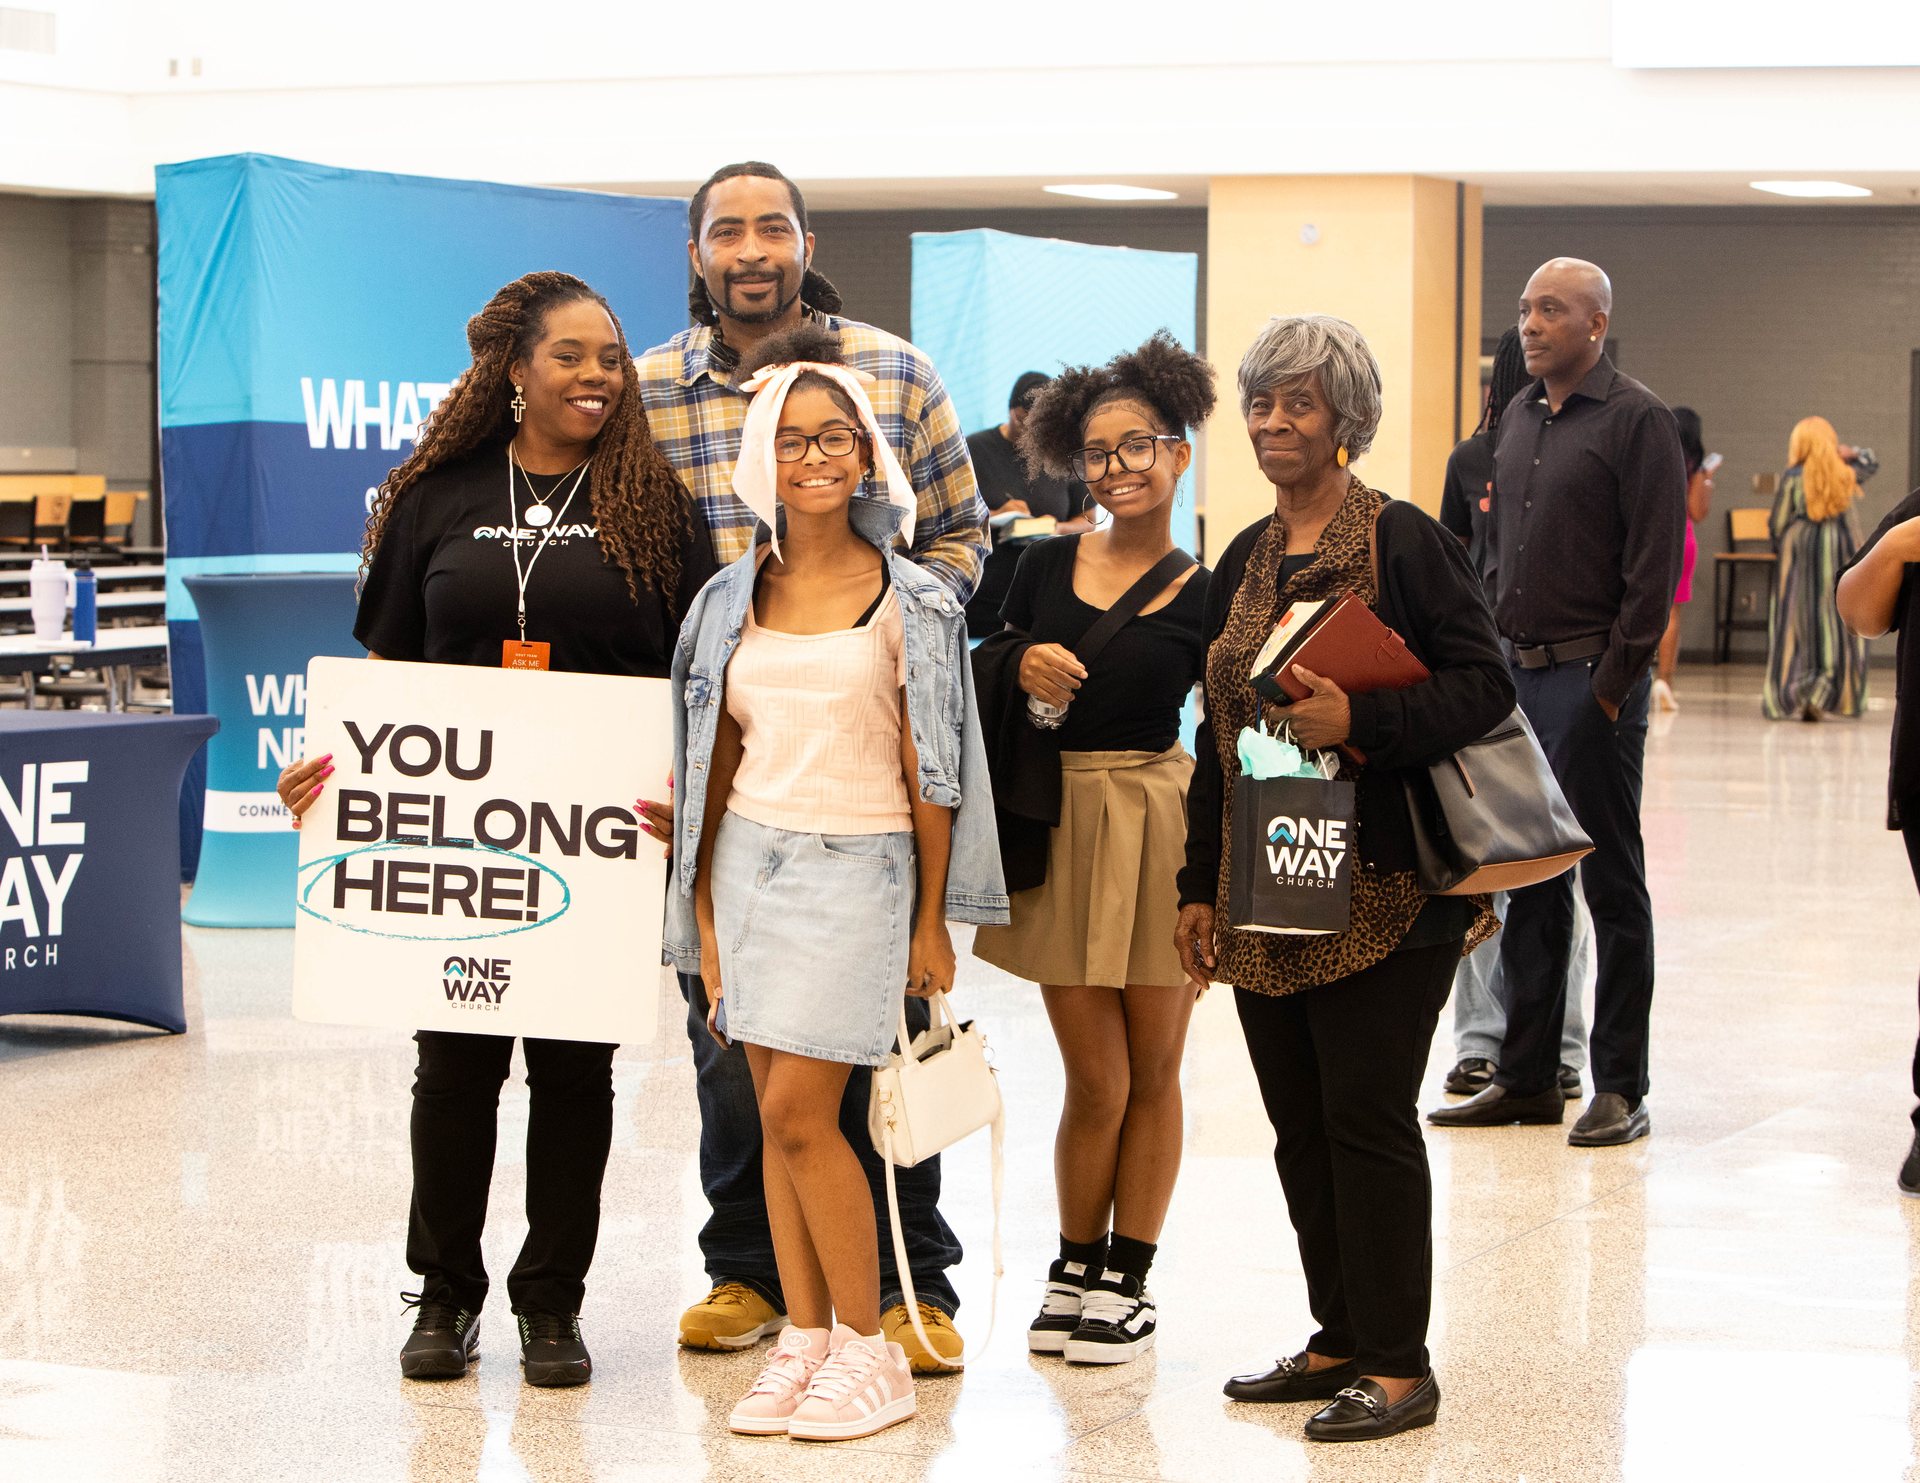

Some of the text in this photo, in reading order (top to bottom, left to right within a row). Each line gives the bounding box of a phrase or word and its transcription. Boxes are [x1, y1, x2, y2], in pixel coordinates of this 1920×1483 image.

[473, 523, 599, 540] ONE WAY
[342, 721, 493, 781] YOU
[337, 788, 638, 860] BELONG
[1267, 815, 1347, 850] ONE
[1266, 845, 1346, 879] WAY
[333, 858, 540, 922] HERE!
[1276, 876, 1334, 889] CHURCH
[443, 956, 511, 981] ONE
[442, 978, 510, 1004] WAY
[451, 1002, 500, 1012] CHURCH
